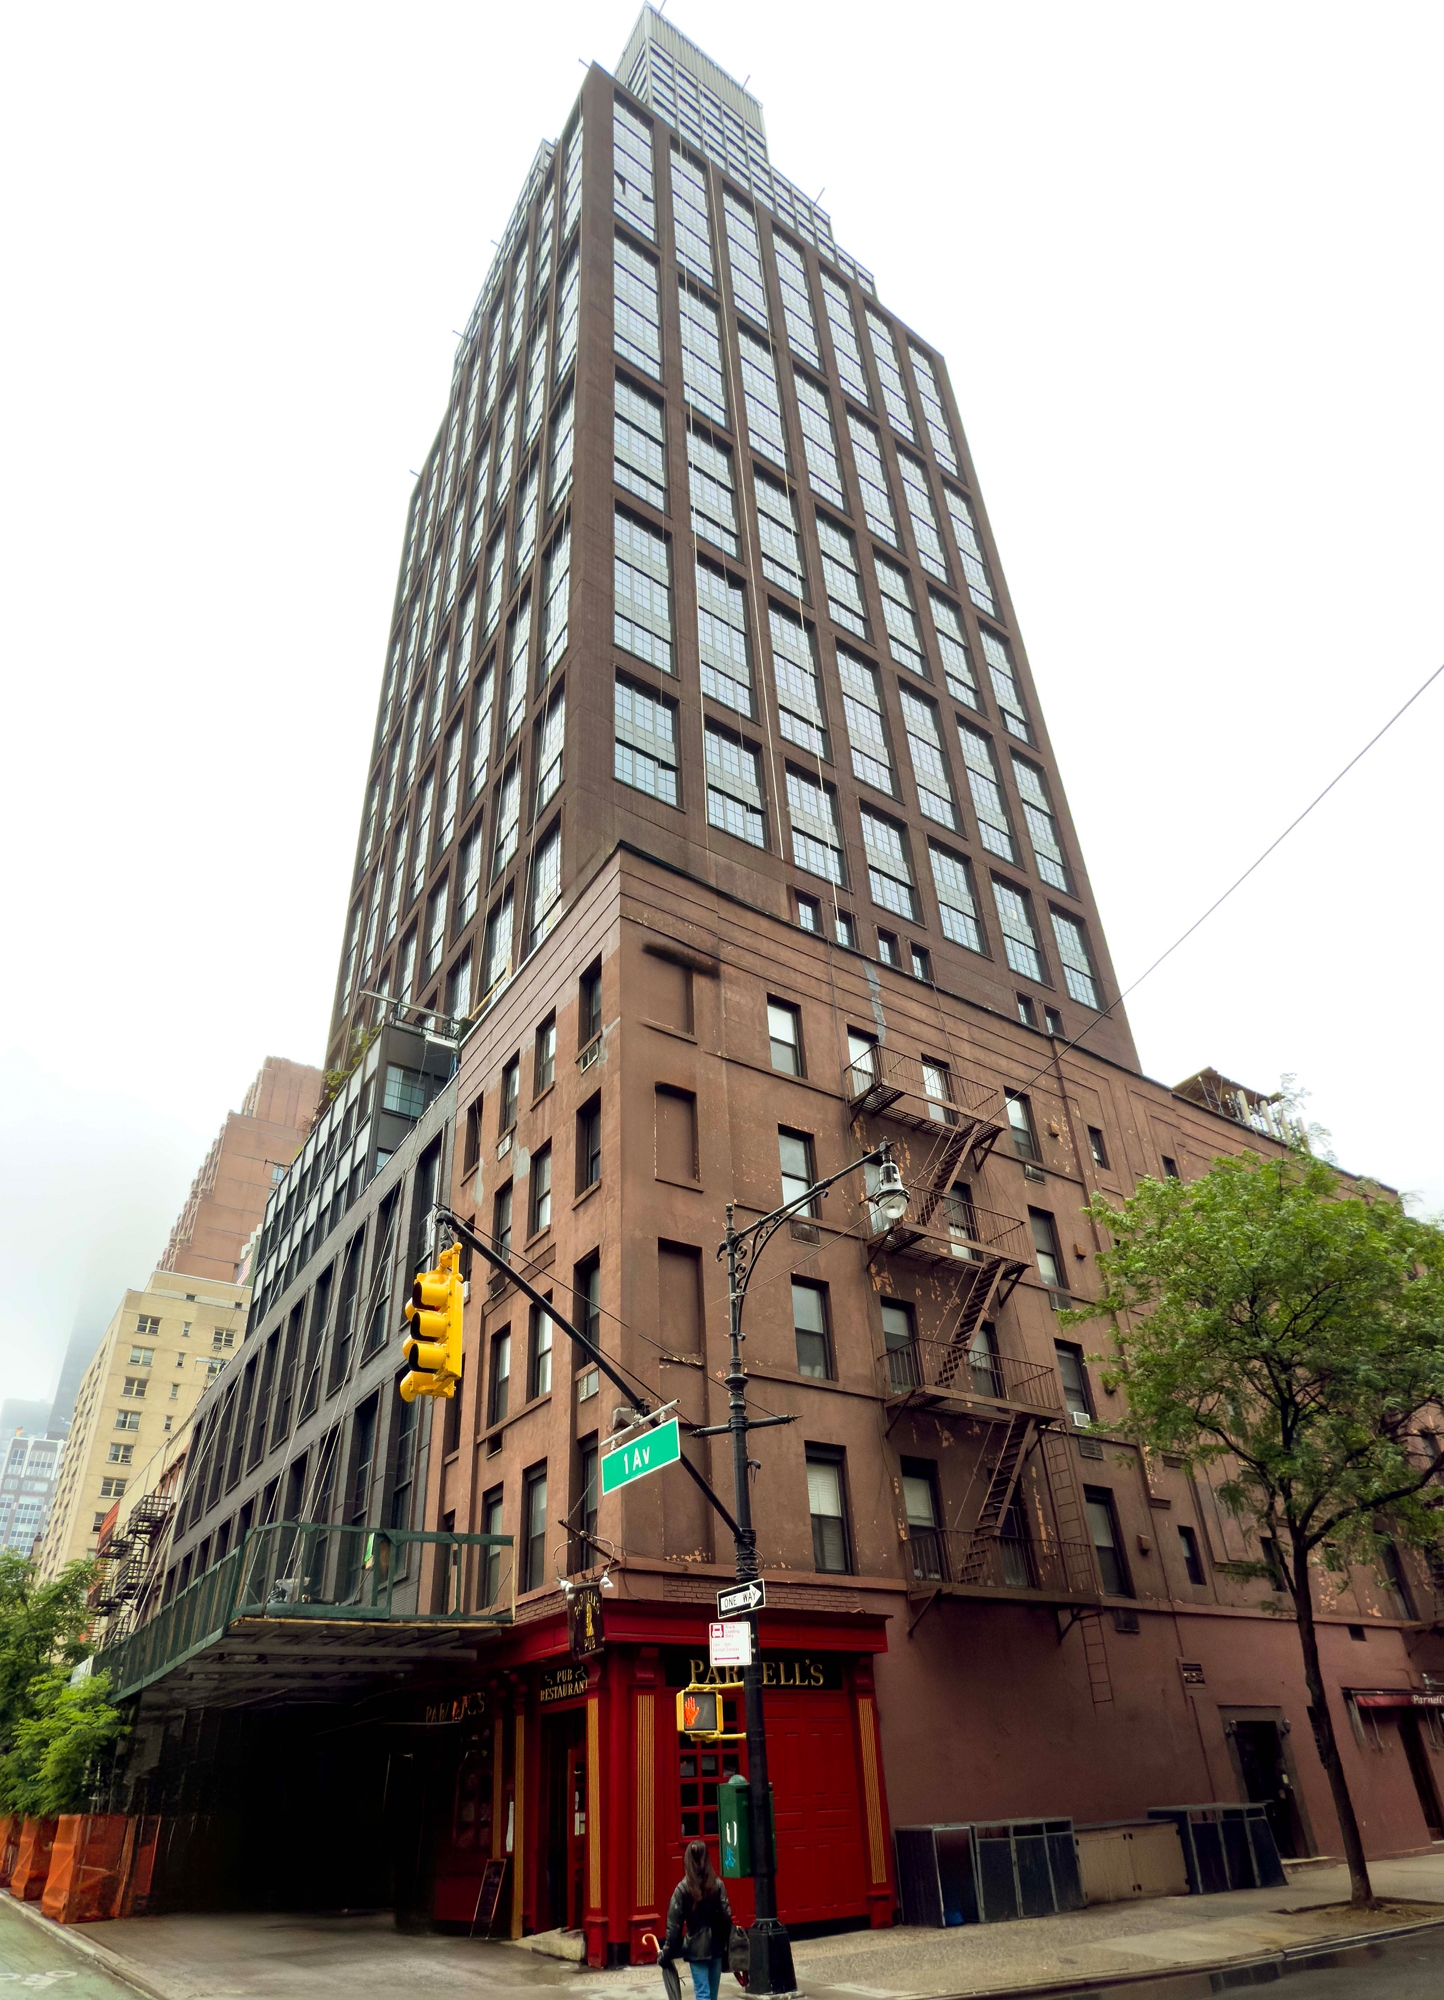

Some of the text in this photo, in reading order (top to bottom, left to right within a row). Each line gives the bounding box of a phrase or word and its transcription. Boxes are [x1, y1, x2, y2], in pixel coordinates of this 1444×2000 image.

[623, 1446, 650, 1475] 1 Av
[724, 1590, 757, 1608] ONE WAY
[584, 1636, 596, 1651] PUB
[557, 1669, 573, 1683] PUB
[690, 1659, 824, 1686] PARELL'S
[540, 1679, 588, 1702] RESTAURANT
